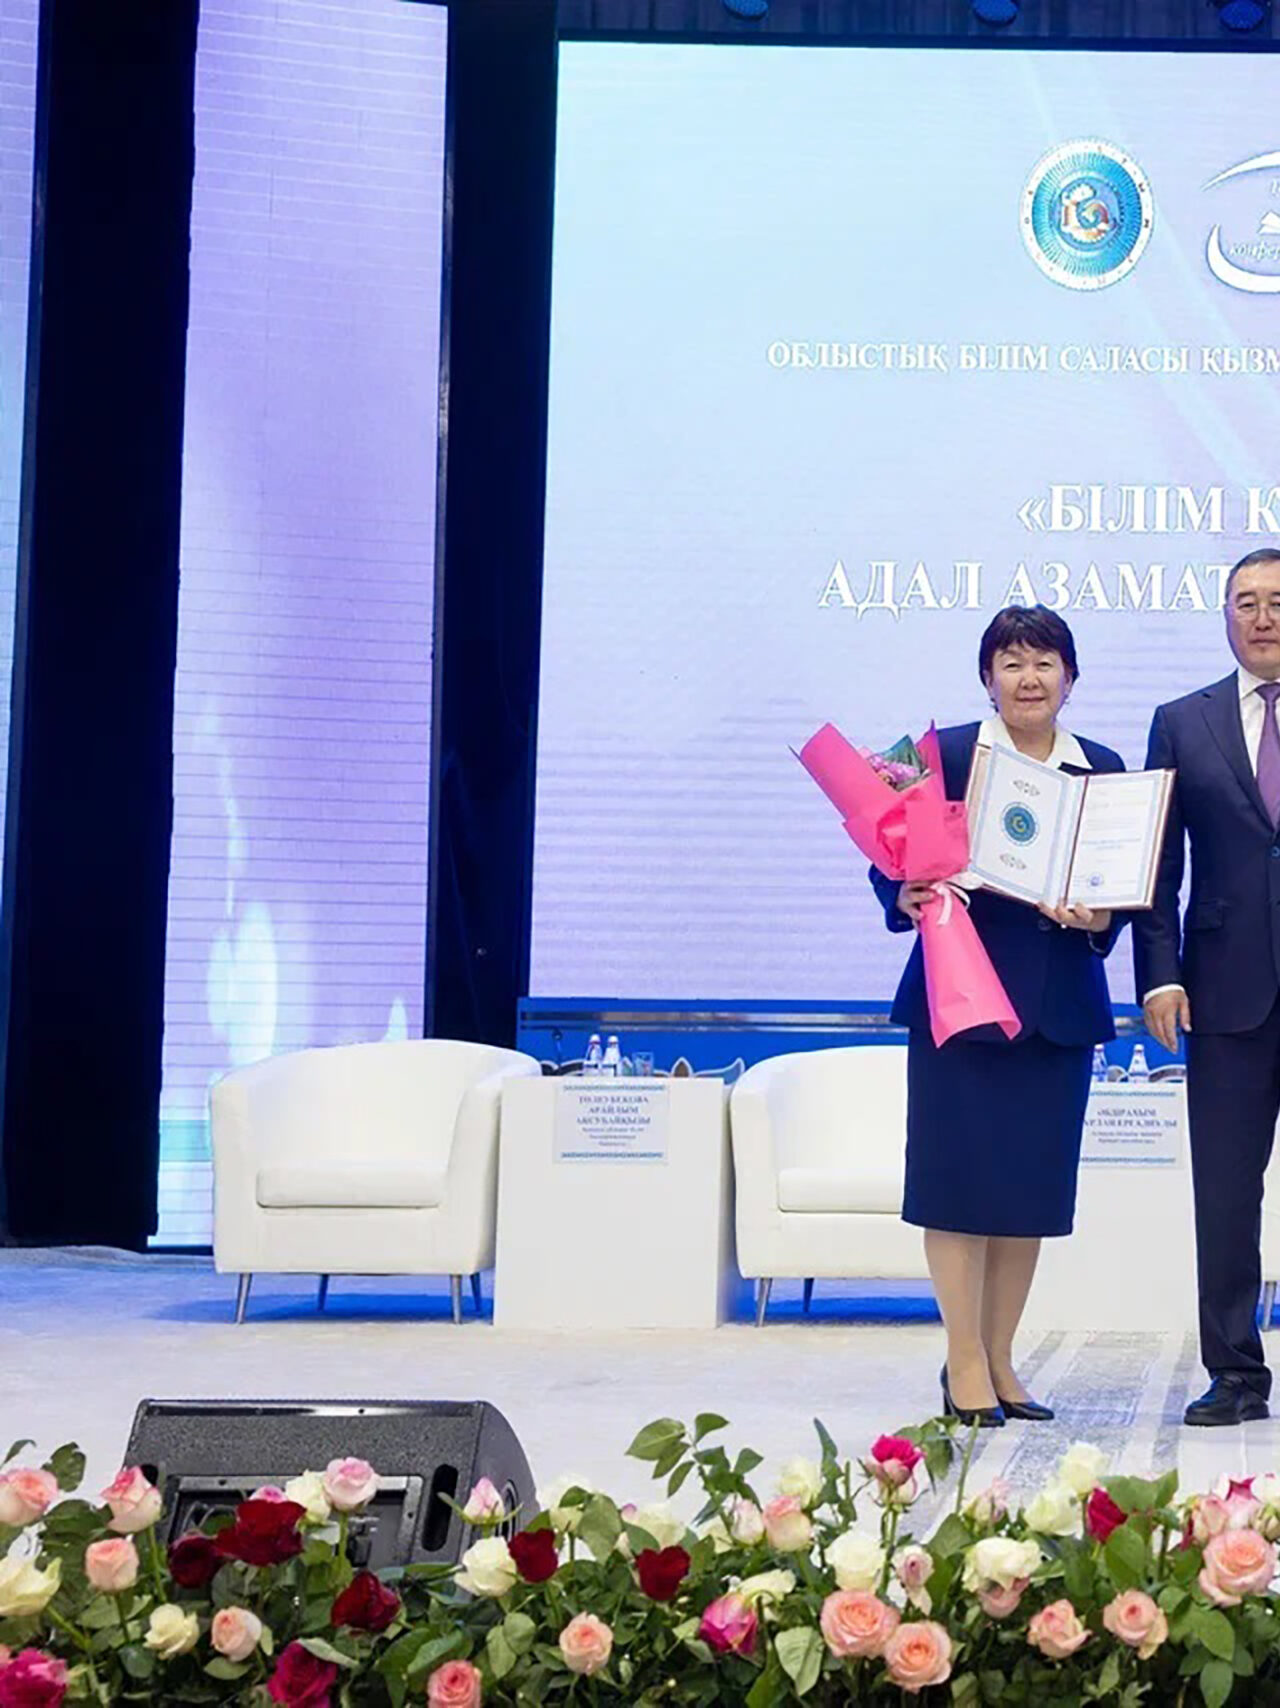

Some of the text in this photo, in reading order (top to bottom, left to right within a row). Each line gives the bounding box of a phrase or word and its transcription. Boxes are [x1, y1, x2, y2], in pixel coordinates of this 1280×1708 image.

[767, 342, 948, 374] ОБЛЫСТЫҚ
[959, 345, 1049, 371] БІЛІМ
[1060, 346, 1189, 373] САЛАСЫ
[1017, 485, 1225, 534] «БІЛІМ
[817, 559, 983, 620] АДАЛ
